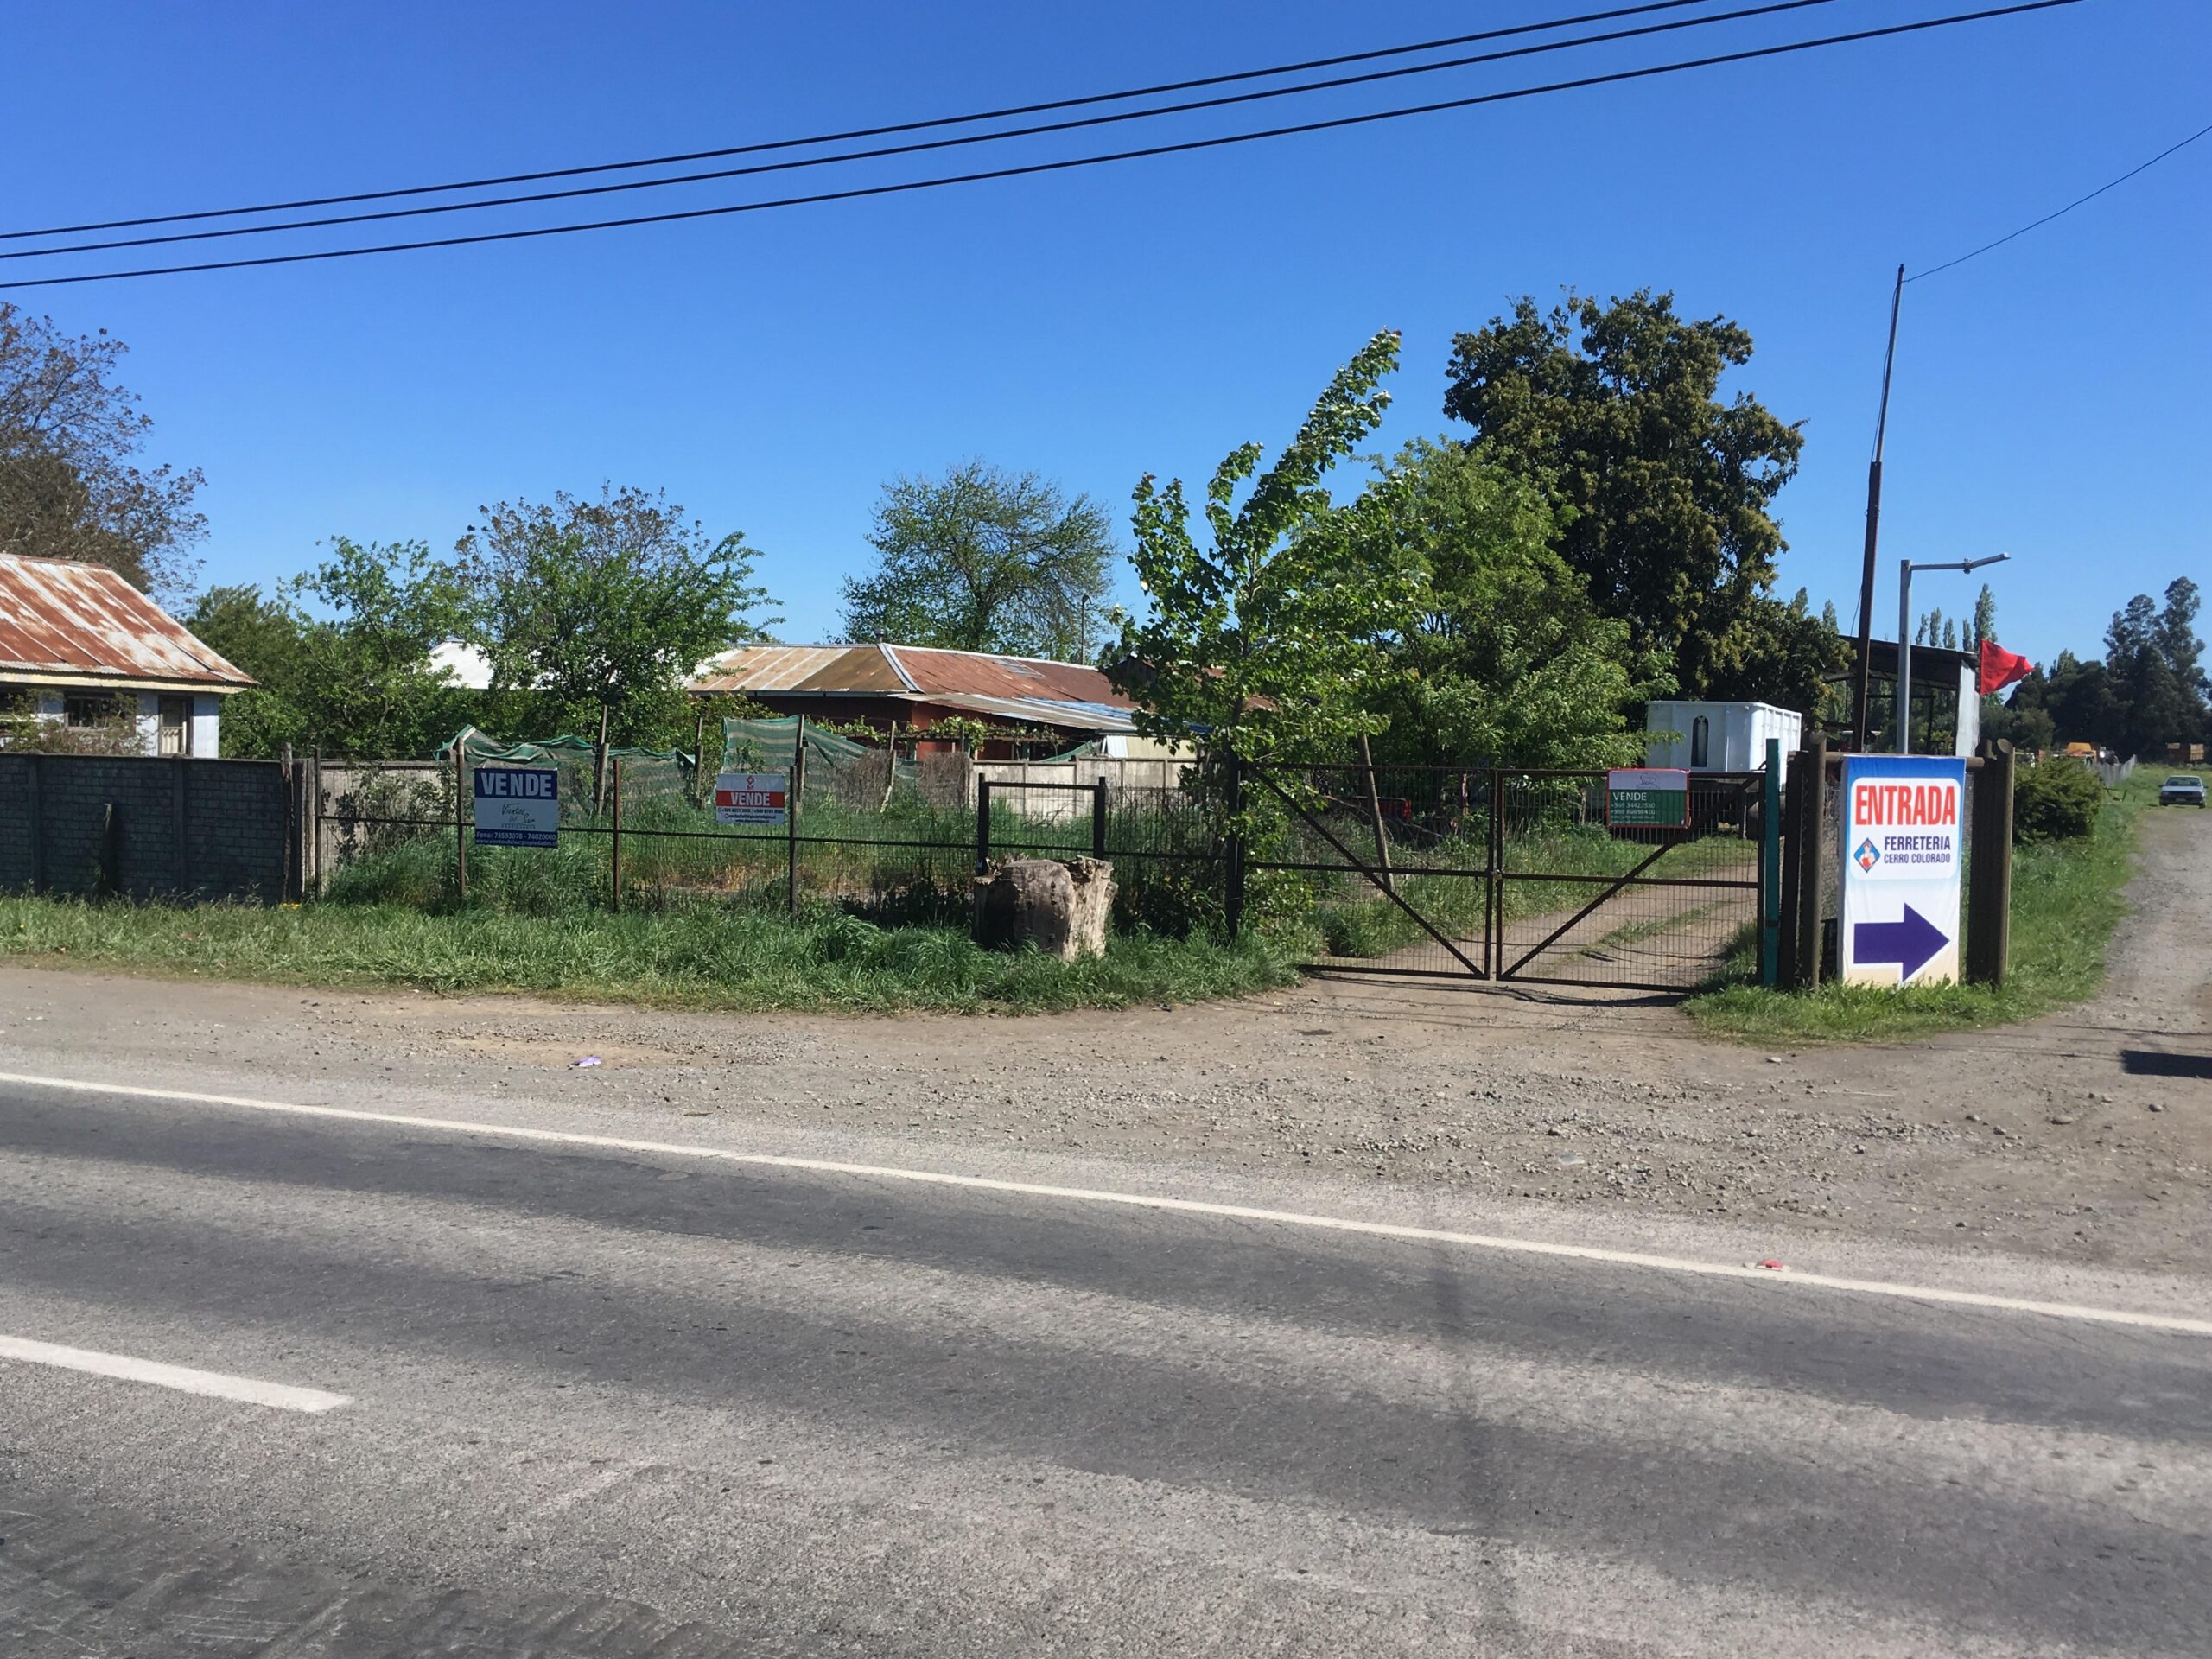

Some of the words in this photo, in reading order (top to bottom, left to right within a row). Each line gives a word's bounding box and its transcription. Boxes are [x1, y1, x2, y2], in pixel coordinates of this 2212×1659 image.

[480, 772, 552, 797] VENDE
[730, 791, 771, 806] VENDE
[1612, 791, 1648, 802] VENDE
[1855, 785, 1956, 825] ENTRADA
[1885, 836, 1951, 851] FERRETERIA
[1884, 854, 1910, 864] CERRO
[1911, 853, 1951, 864] COLORADO
